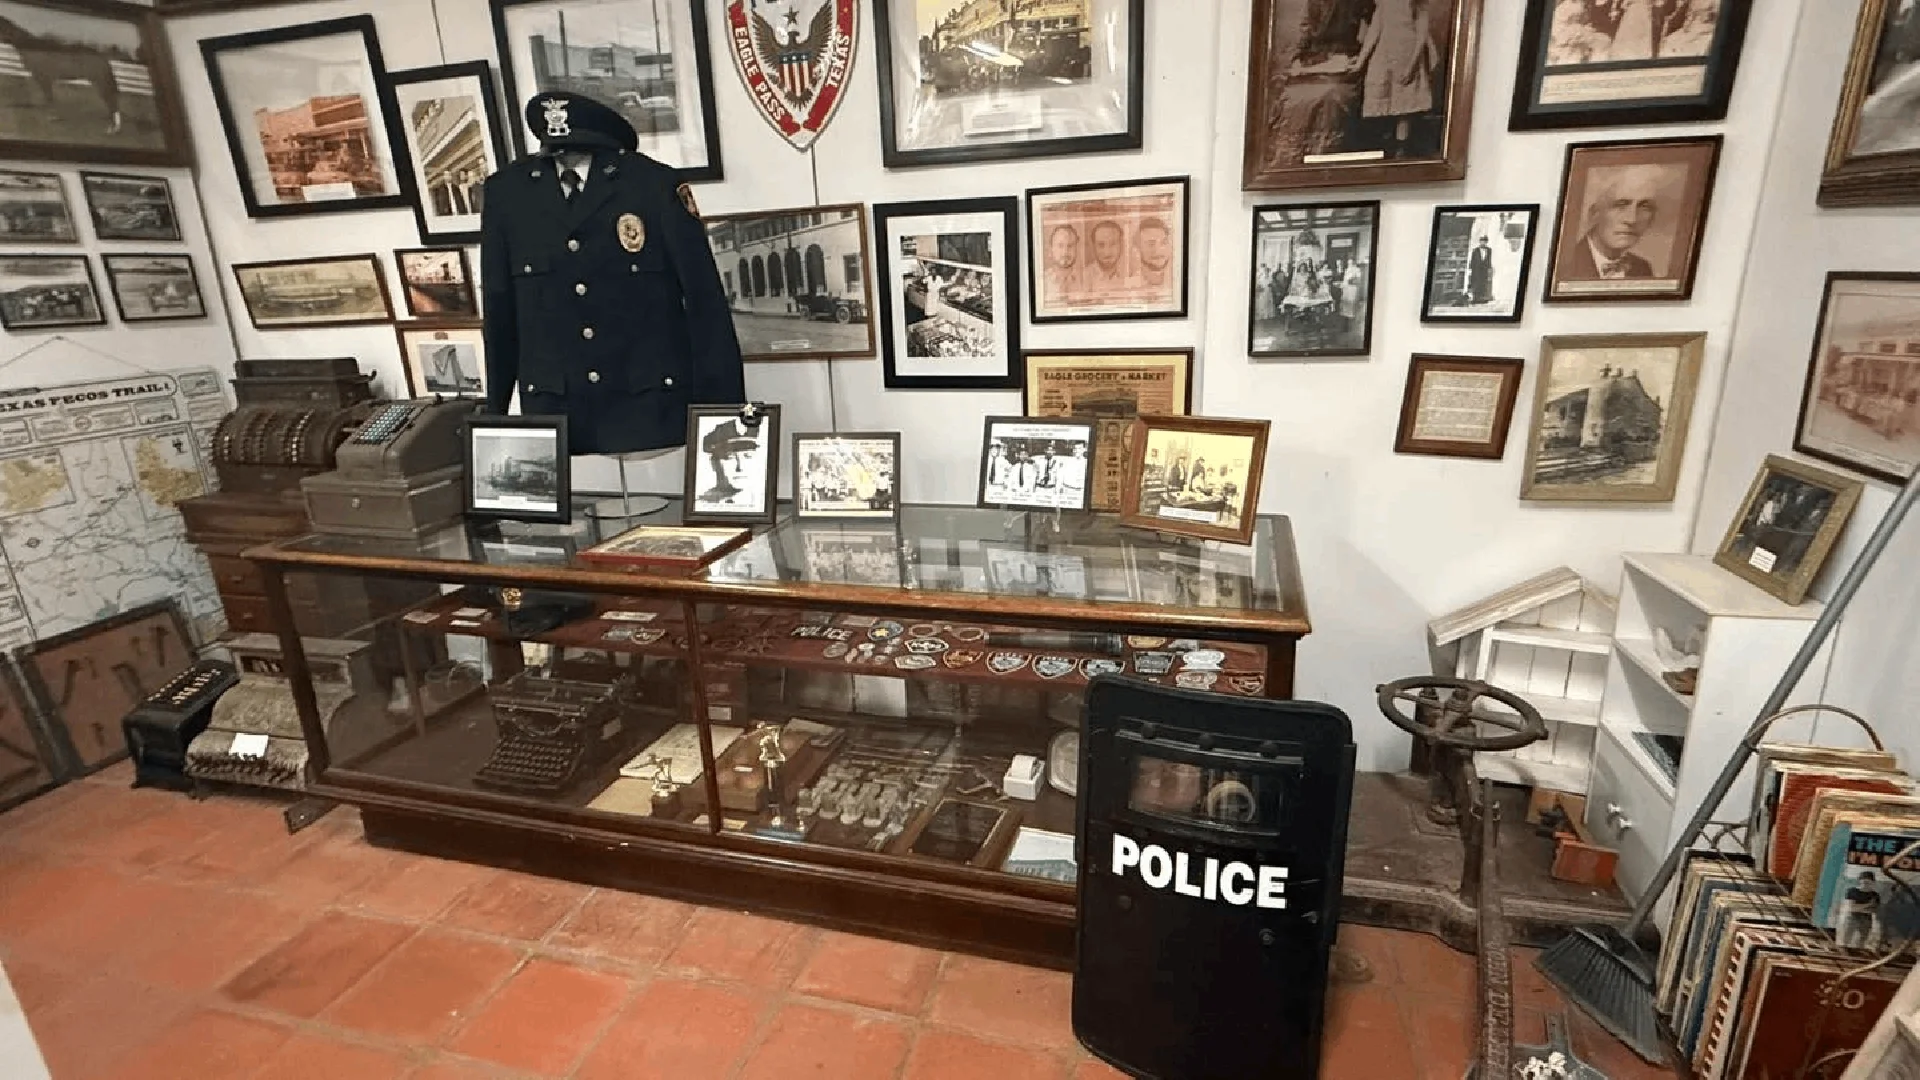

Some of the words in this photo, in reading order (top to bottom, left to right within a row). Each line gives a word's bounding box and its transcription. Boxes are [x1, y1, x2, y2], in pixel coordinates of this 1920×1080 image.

[734, 26, 759, 77] EAGLE
[755, 82, 786, 121] PASS
[824, 34, 851, 88] TEXAS
[48, 390, 109, 406] PECOS
[1111, 832, 1290, 909] POLICE
[1854, 836, 1897, 853] THE
